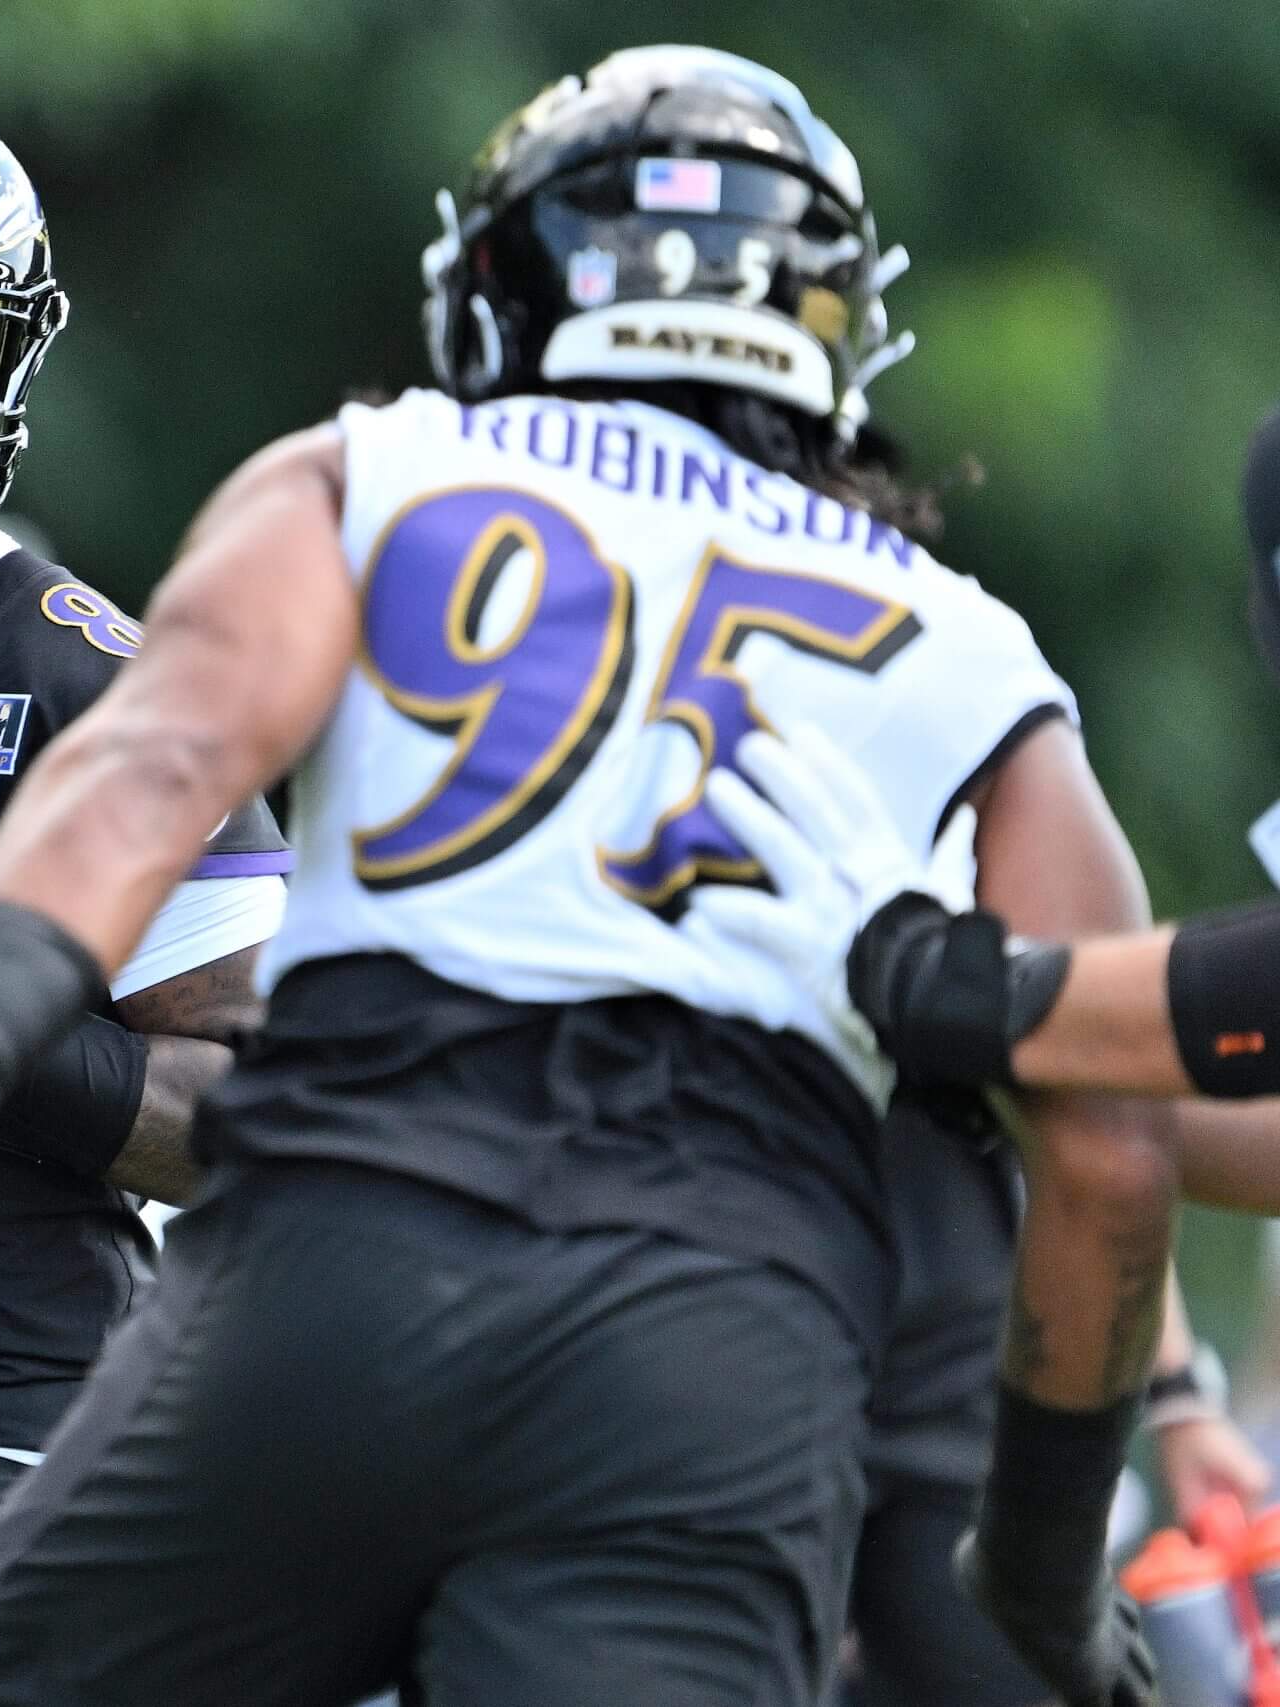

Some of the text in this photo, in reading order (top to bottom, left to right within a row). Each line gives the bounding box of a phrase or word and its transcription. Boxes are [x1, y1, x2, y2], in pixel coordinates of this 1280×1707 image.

[610, 325, 793, 375] RAVENS
[458, 405, 912, 569] ROBINSON
[40, 583, 146, 659] 8
[352, 484, 924, 925] 95
